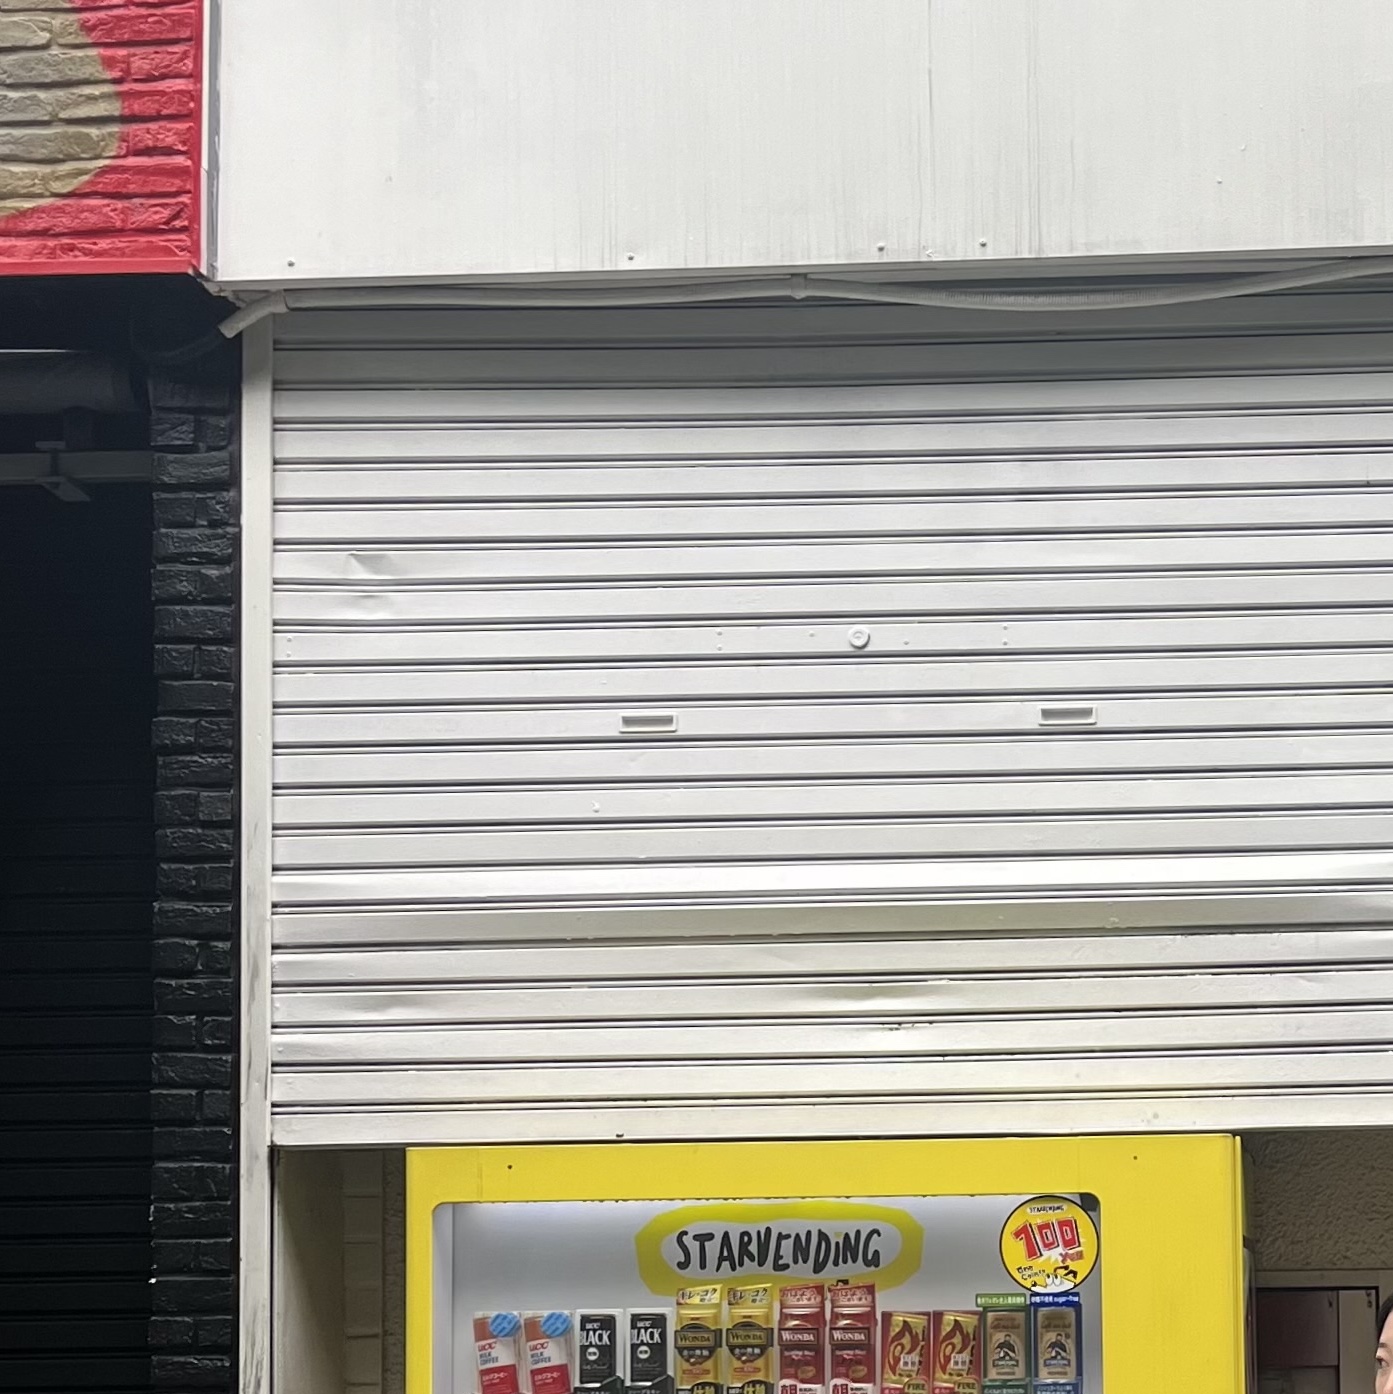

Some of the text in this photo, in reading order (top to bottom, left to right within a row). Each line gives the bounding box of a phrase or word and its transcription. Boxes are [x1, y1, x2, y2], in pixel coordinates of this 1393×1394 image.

[1011, 1217, 1081, 1262] 100
[675, 1226, 882, 1274] STARVENDING
[580, 1330, 611, 1345] BLACK
[631, 1328, 662, 1343] BLACK
[678, 1334, 711, 1343] WONDA
[729, 1333, 763, 1342] WONDA
[781, 1331, 815, 1342] WONDA
[832, 1331, 866, 1341] WONDA
